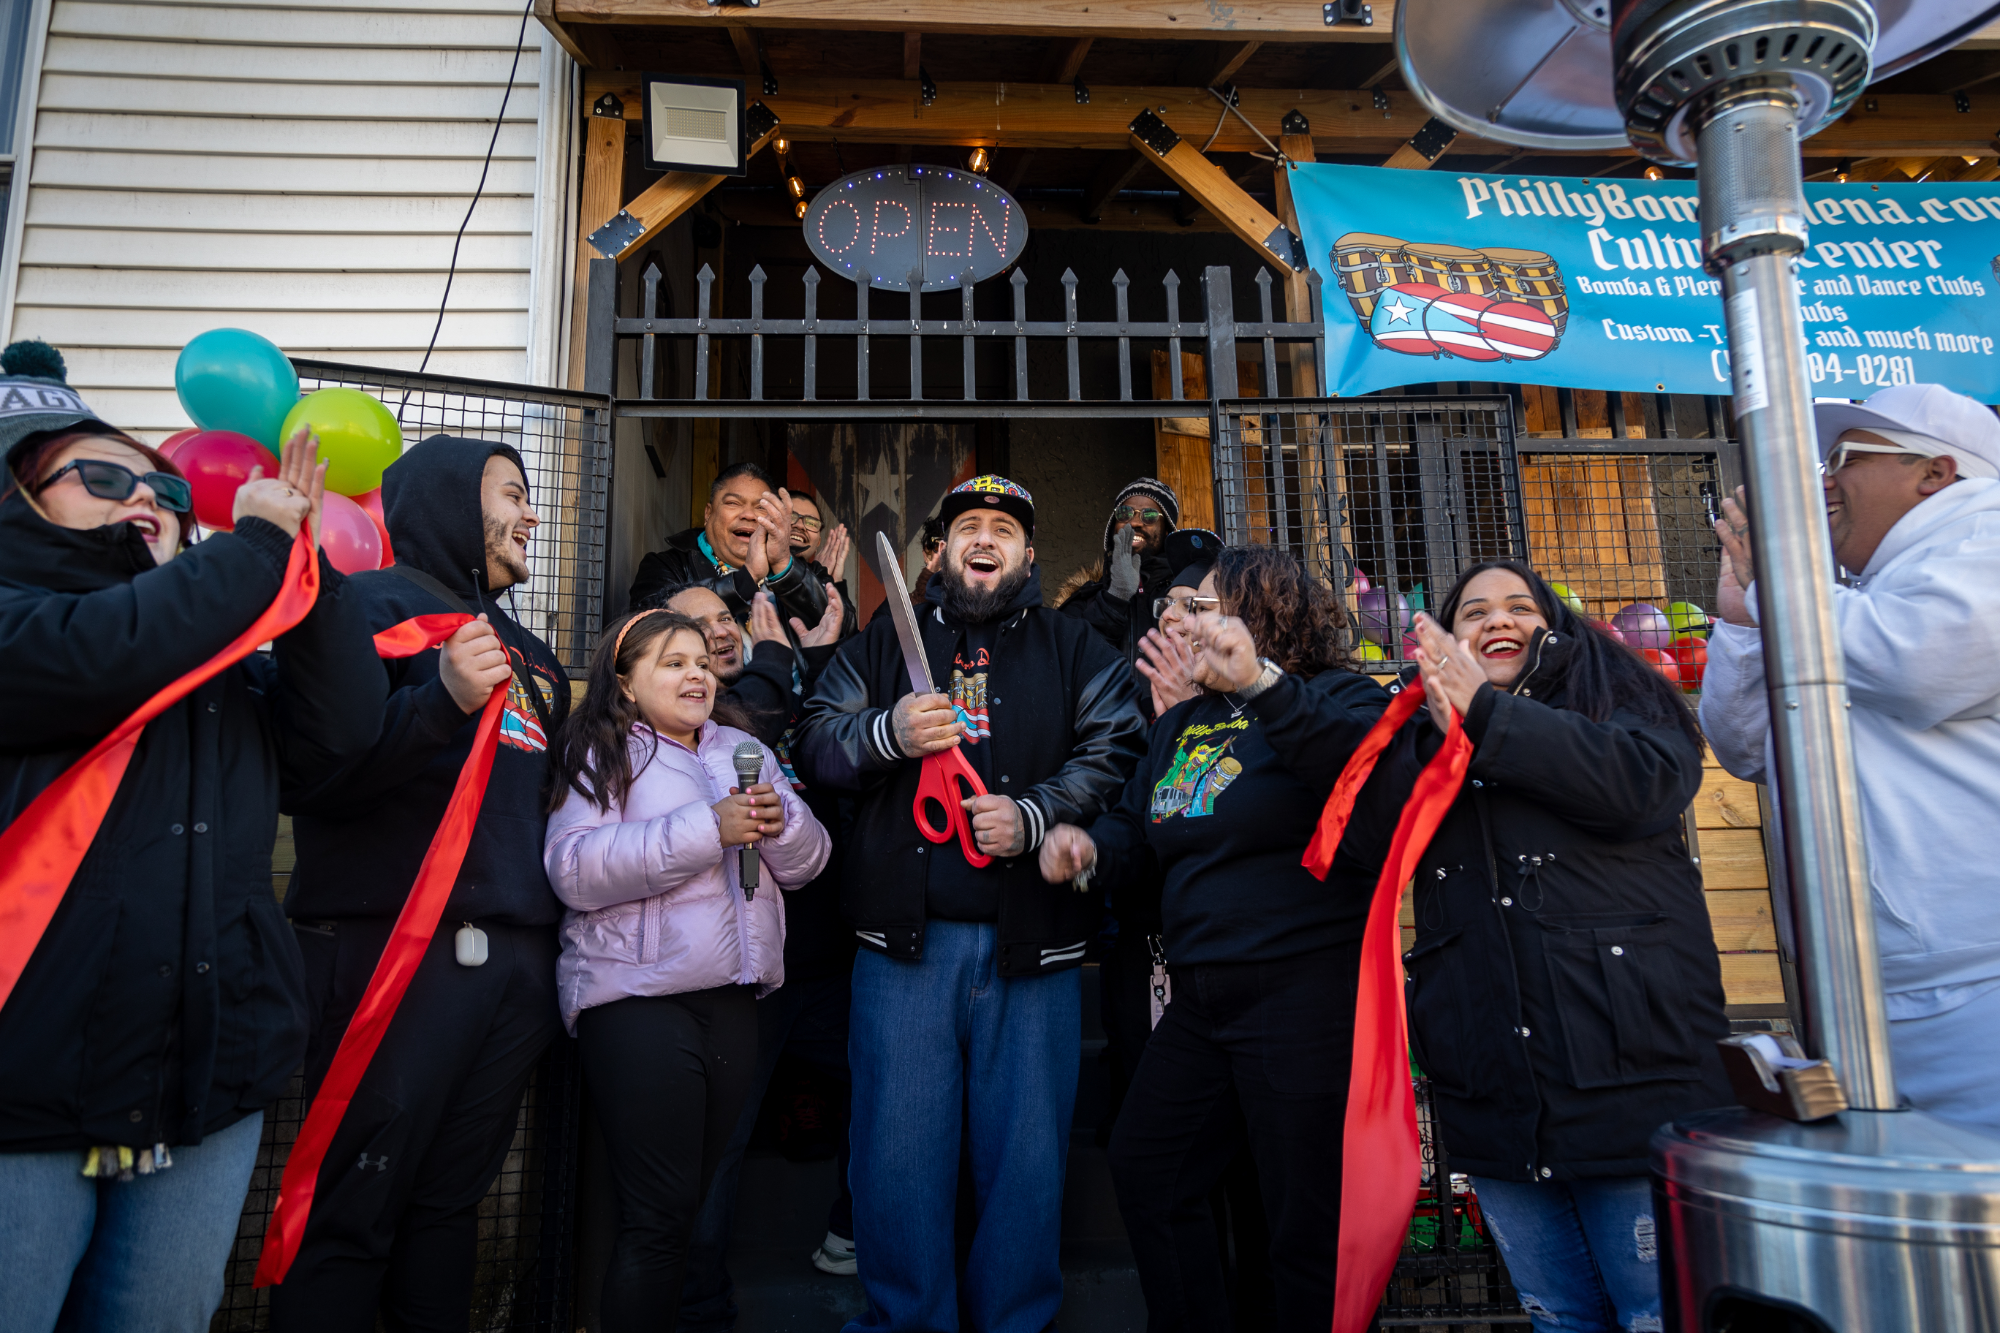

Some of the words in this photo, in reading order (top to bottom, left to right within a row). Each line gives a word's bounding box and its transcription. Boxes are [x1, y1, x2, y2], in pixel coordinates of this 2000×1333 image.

[818, 199, 1010, 258] OPEN
[1587, 227, 1702, 271] Cultu
[1798, 236, 1943, 269] enter
[1575, 275, 1653, 297] Bomba
[1655, 276, 1672, 297] &
[1673, 275, 1722, 298] Plen
[1813, 274, 1854, 296] and
[1854, 274, 1922, 296] Dance
[1925, 274, 1986, 298] Clubs
[1800, 300, 1849, 323] ubs
[1601, 318, 1695, 343] Custom
[1815, 325, 1863, 347] and
[1863, 325, 1932, 351] much
[1934, 331, 1995, 355] more
[1807, 352, 1917, 386] 04-0281
